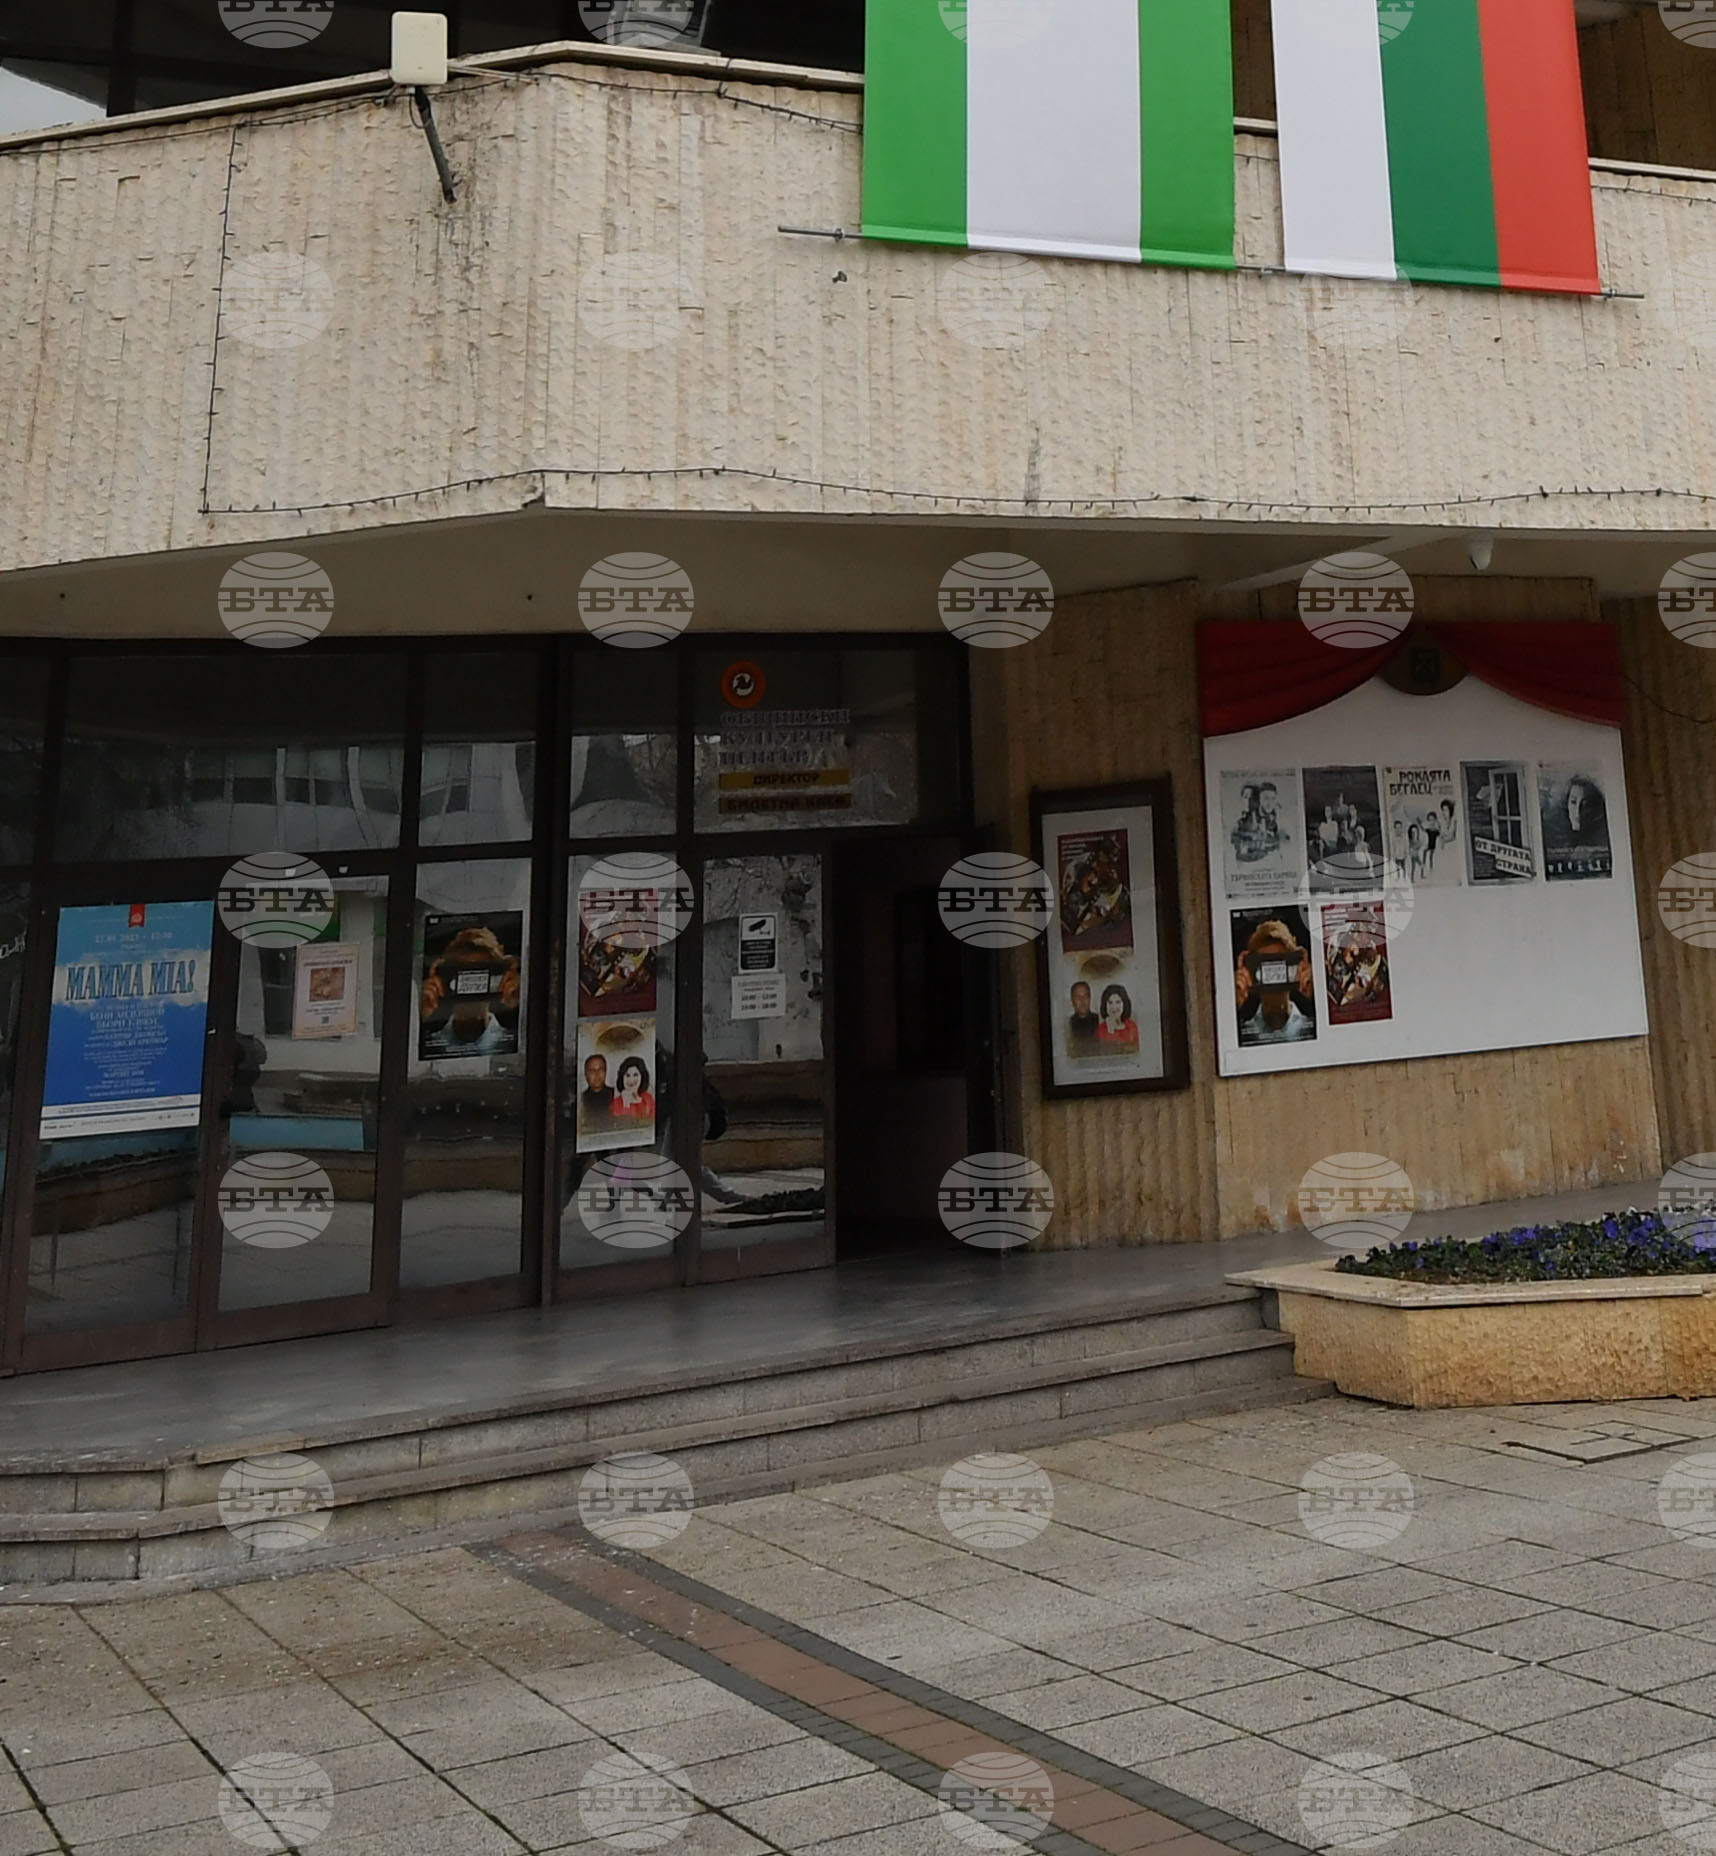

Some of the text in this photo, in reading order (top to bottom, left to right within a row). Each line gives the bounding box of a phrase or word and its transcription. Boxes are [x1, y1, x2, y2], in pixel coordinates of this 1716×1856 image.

[1399, 769, 1451, 783] РОКЛЯТА
[1389, 782, 1433, 796] БЕГЛЕЦ
[66, 959, 196, 1001] MAMMA MIA!
